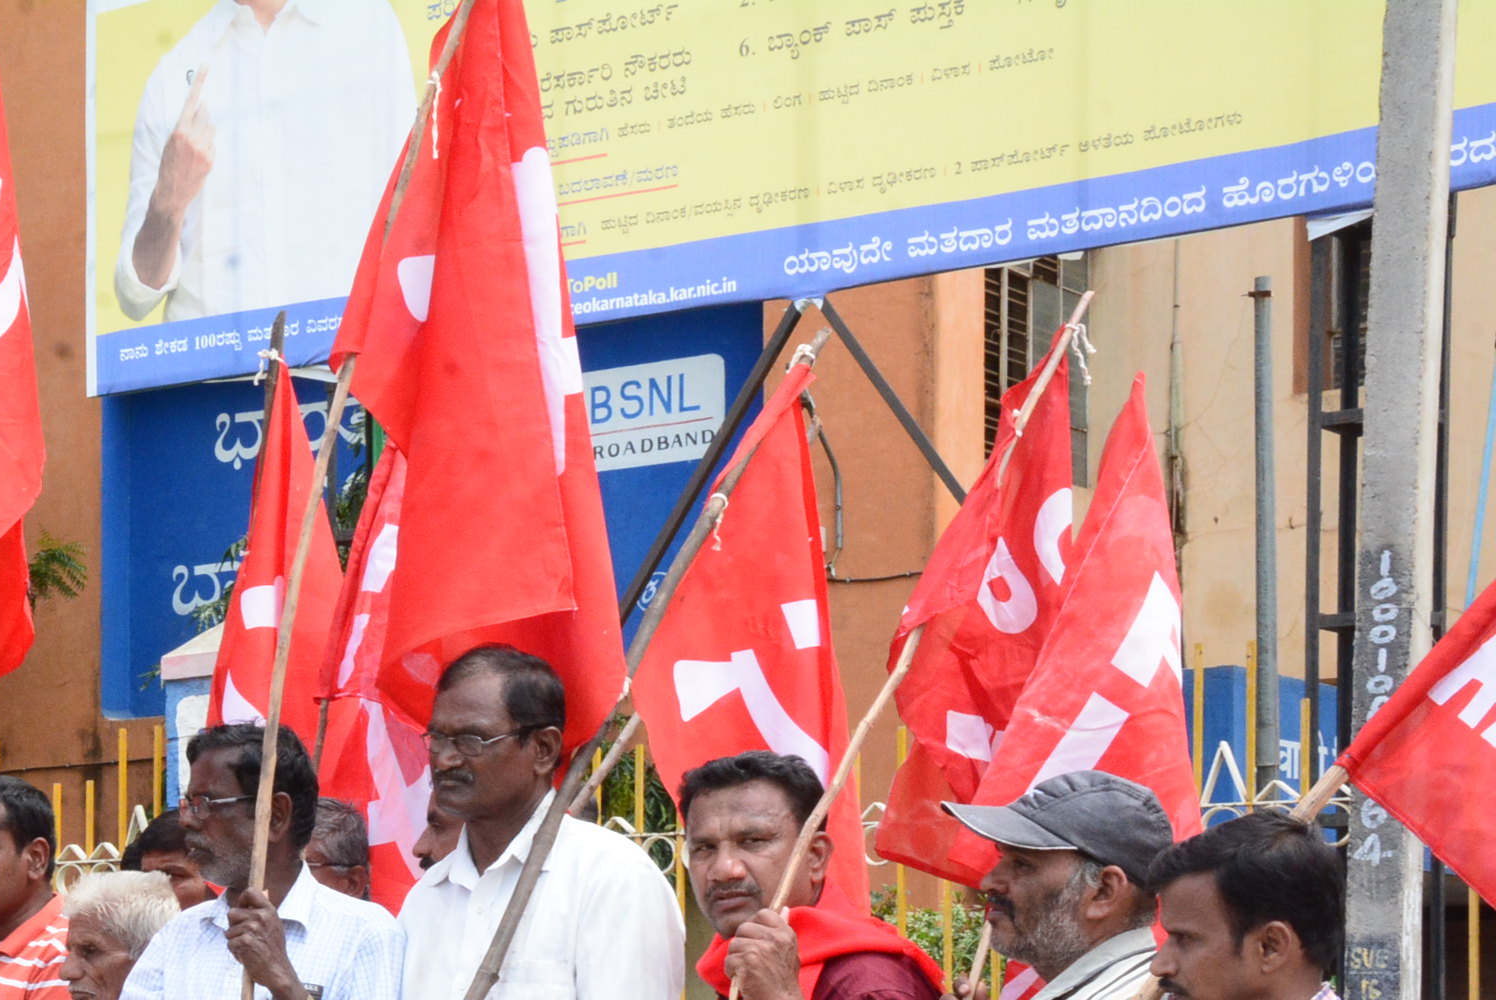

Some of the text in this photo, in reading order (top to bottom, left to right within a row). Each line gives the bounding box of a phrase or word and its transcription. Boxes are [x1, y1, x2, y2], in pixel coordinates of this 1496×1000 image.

[738, 37, 756, 57] 6.
[954, 161, 963, 176] 2
[783, 235, 893, 276] ಯಾವುದೇ
[906, 217, 1013, 258] ಮತದಾರ
[1026, 183, 1207, 242] ಮತದಾನದಿಂದ
[570, 276, 738, 315] eokarnataka.kar.nic.in
[590, 373, 702, 426] BSNL
[592, 428, 717, 461] ROADBAND
